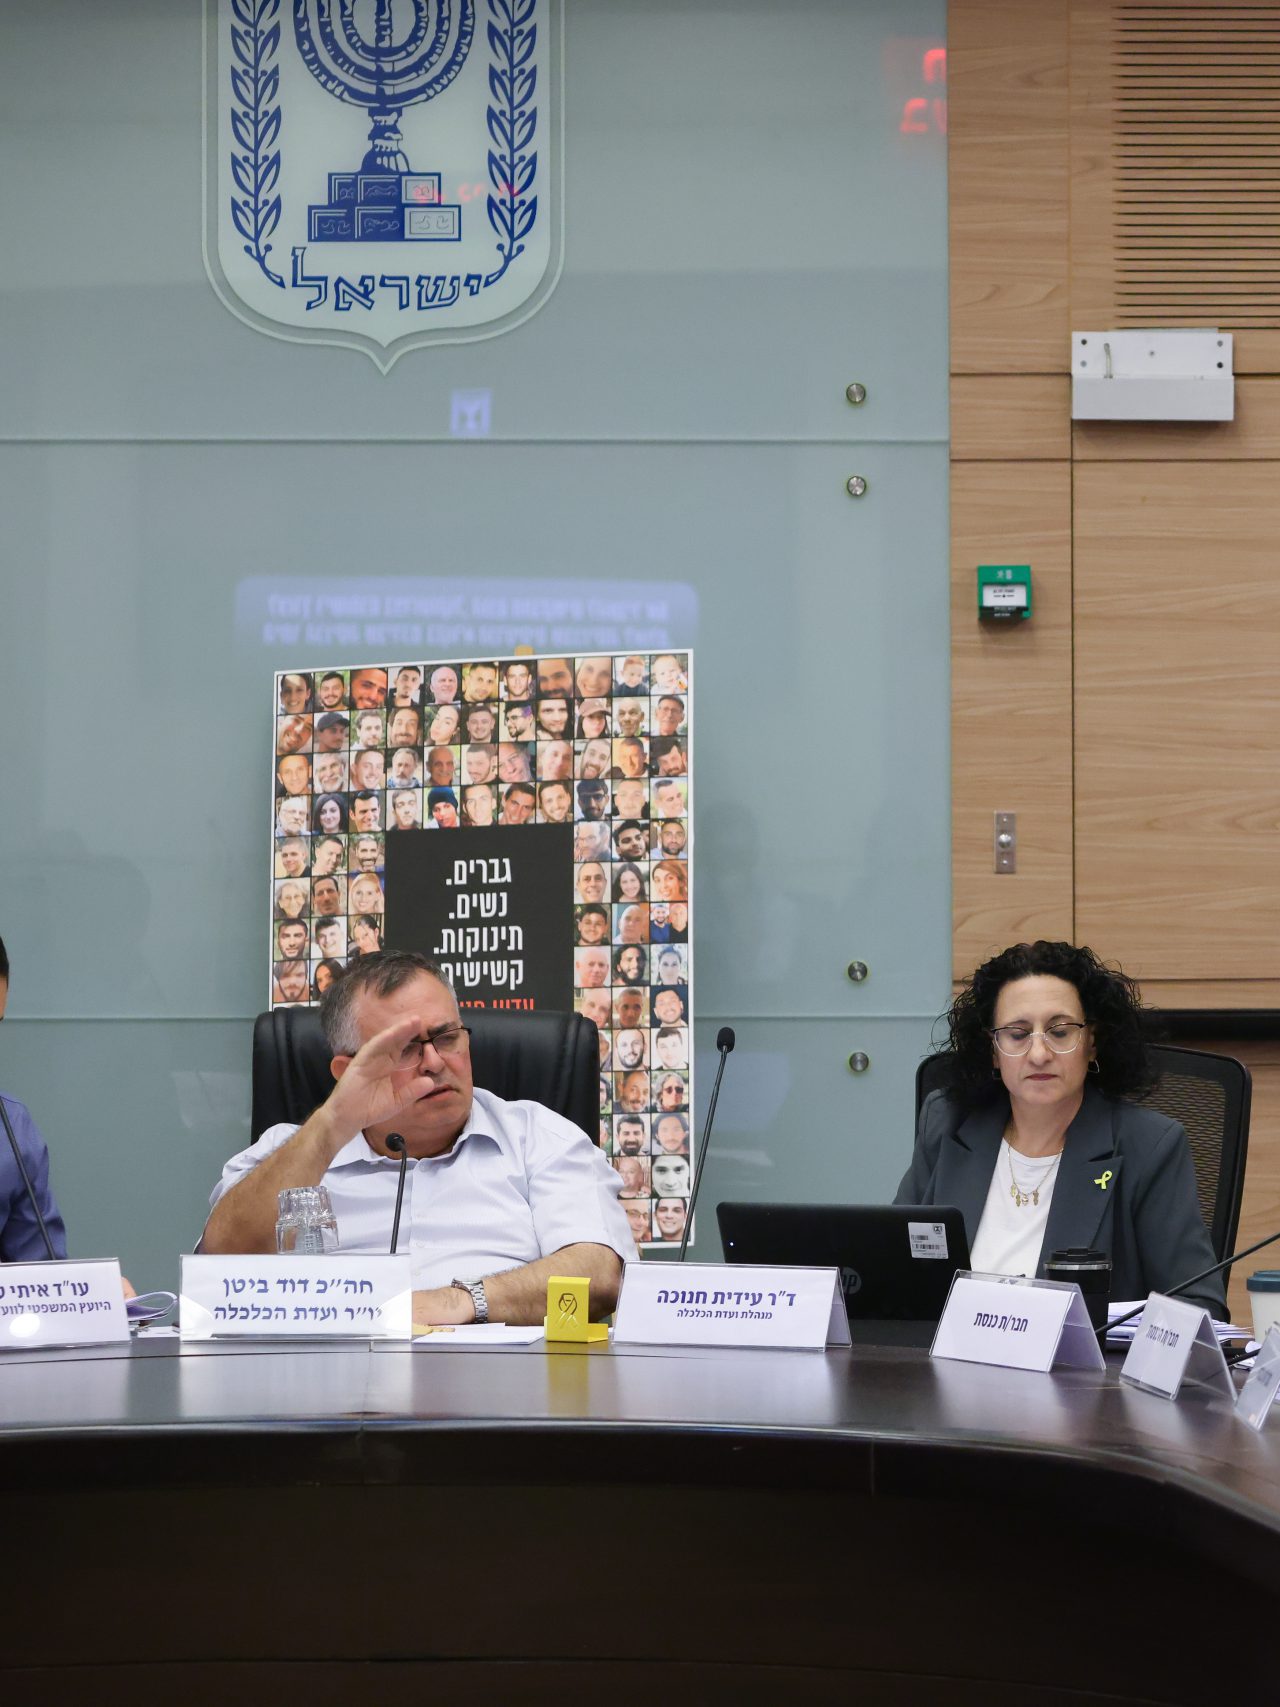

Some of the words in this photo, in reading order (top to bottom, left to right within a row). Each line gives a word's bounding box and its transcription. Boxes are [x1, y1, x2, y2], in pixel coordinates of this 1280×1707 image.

[291, 246, 482, 311] ישראל
[446, 858, 512, 886] גברים.
[449, 892, 508, 919] נשים.
[433, 926, 524, 958] תינוקות.
[10, 1284, 49, 1299] איתי
[53, 1280, 89, 1296] עו"ד
[222, 1278, 270, 1297] ביטן
[276, 1278, 310, 1294] דוד
[316, 1278, 374, 1294] חה"כ
[657, 1290, 708, 1304] חנוכה
[711, 1291, 763, 1307] עידית
[768, 1290, 797, 1307] ד"ר
[0, 1303, 24, 1316] לווע
[28, 1304, 76, 1314] המשפטי
[79, 1301, 111, 1314] היועץ
[214, 1303, 287, 1320] הכלכלה
[293, 1306, 338, 1321] ועדת
[677, 1308, 713, 1318] הכלכלה
[714, 1310, 739, 1319] ועדת
[740, 1309, 773, 1320] מנהלת
[973, 1312, 999, 1328] כנסת
[998, 1314, 1029, 1332] חבר/ת
